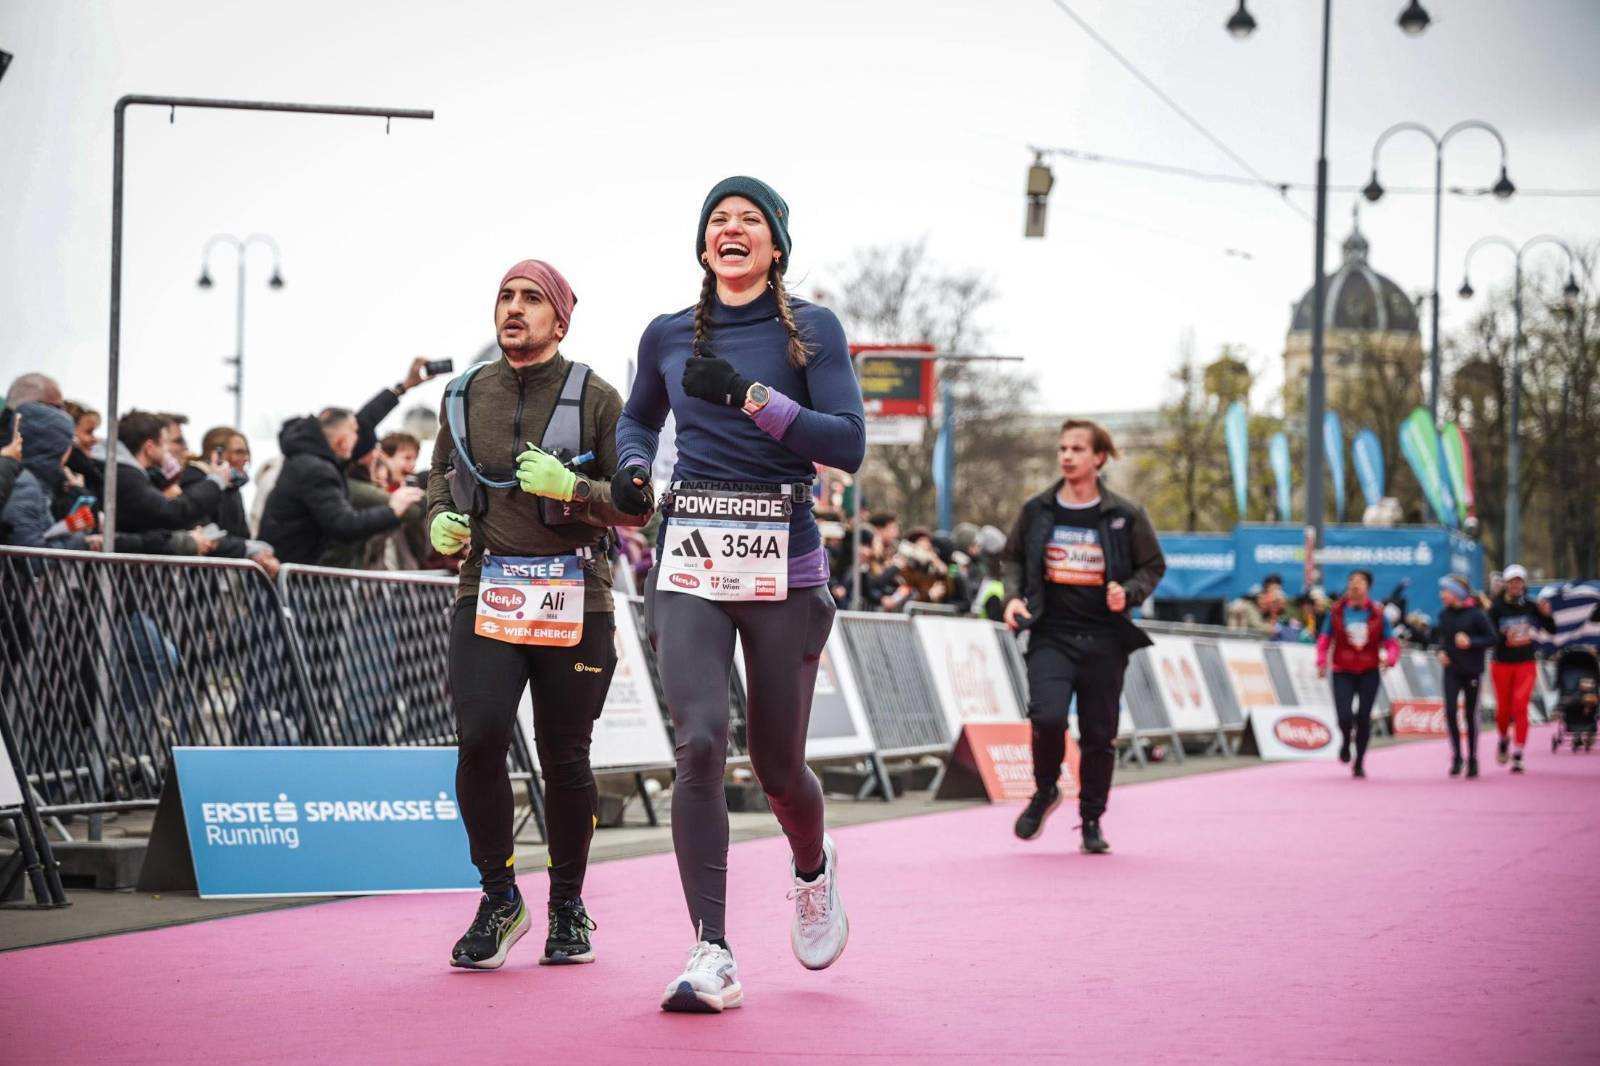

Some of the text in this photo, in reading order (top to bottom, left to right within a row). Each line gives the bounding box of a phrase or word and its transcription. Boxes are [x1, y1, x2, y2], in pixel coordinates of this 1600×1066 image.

[674, 495, 784, 517] POWERADE
[721, 534, 781, 559] 354A
[502, 563, 546, 577] ERSTE
[722, 576, 740, 584] Stadt
[486, 590, 523, 607] Hervis
[540, 592, 565, 611] Ali
[504, 627, 578, 639] WIEN ENERGIE
[202, 800, 434, 824] ERSTE SPARKASSE
[207, 824, 300, 850] Running
